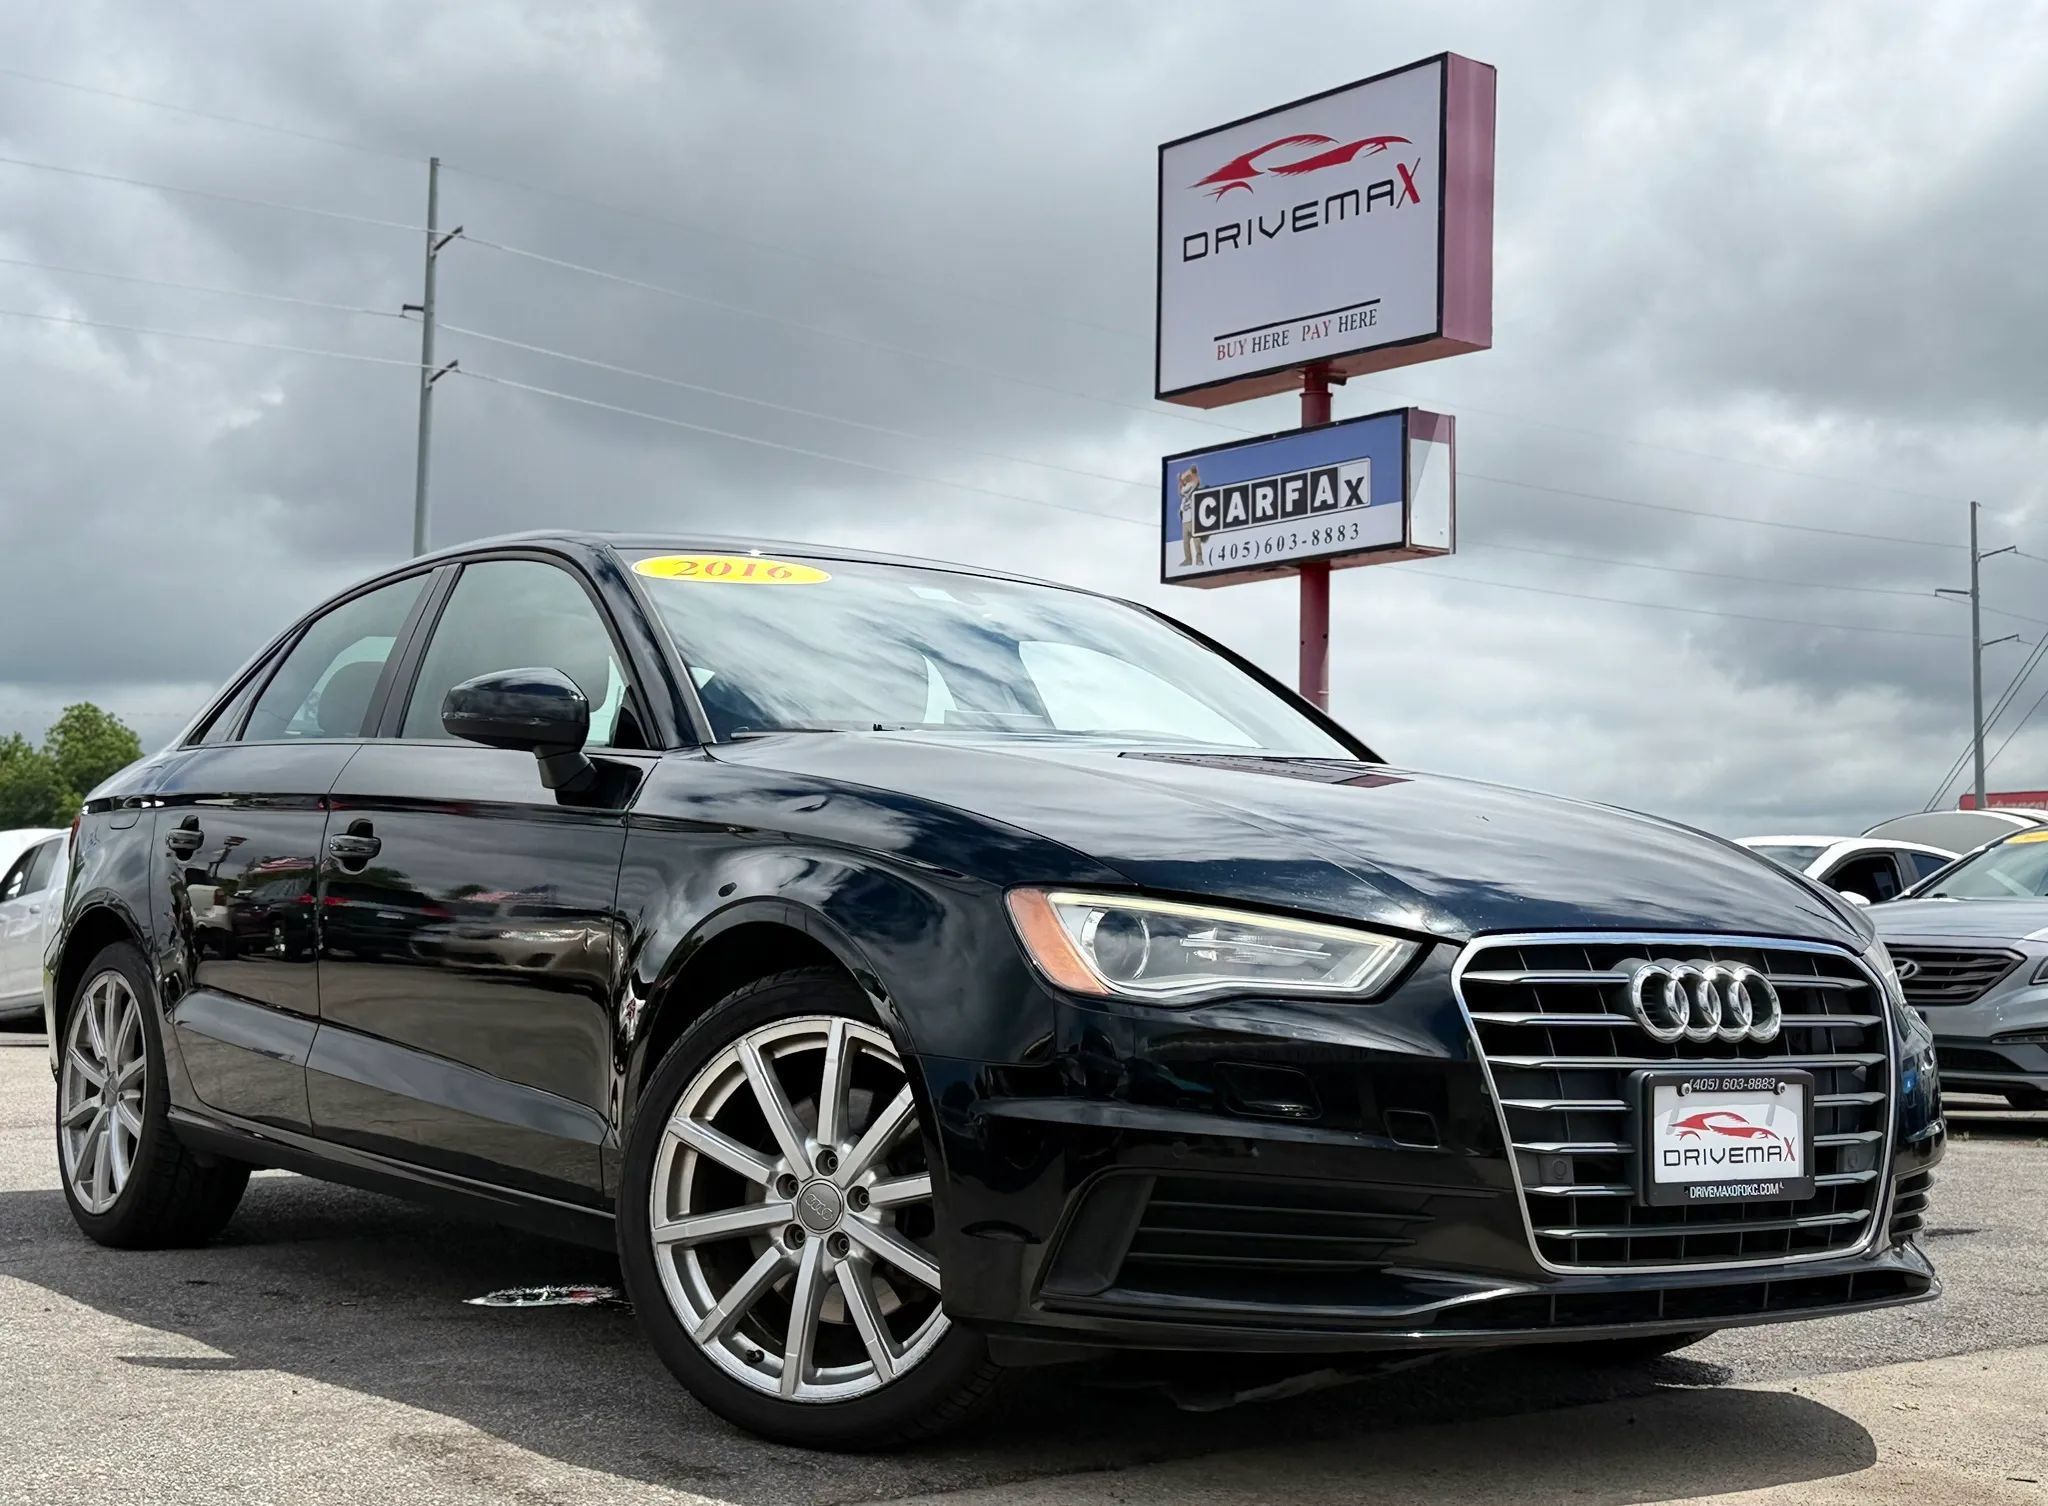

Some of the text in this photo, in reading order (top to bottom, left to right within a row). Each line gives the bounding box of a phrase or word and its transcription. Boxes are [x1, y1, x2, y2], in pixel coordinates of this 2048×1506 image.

[1183, 157, 1421, 262] DRIVEMAX
[1216, 308, 1378, 361] BUY HERE PAY HERE
[1197, 474, 1366, 528] CARFAX
[1208, 522, 1360, 566] (405)603-8883
[673, 560, 793, 580] 2016
[1689, 1077, 1776, 1091] (405) 603-8883
[1663, 1136, 1796, 1167] DRIVEMAX
[1689, 1183, 1779, 1199] DRIVEMAXOFOKC.COM
